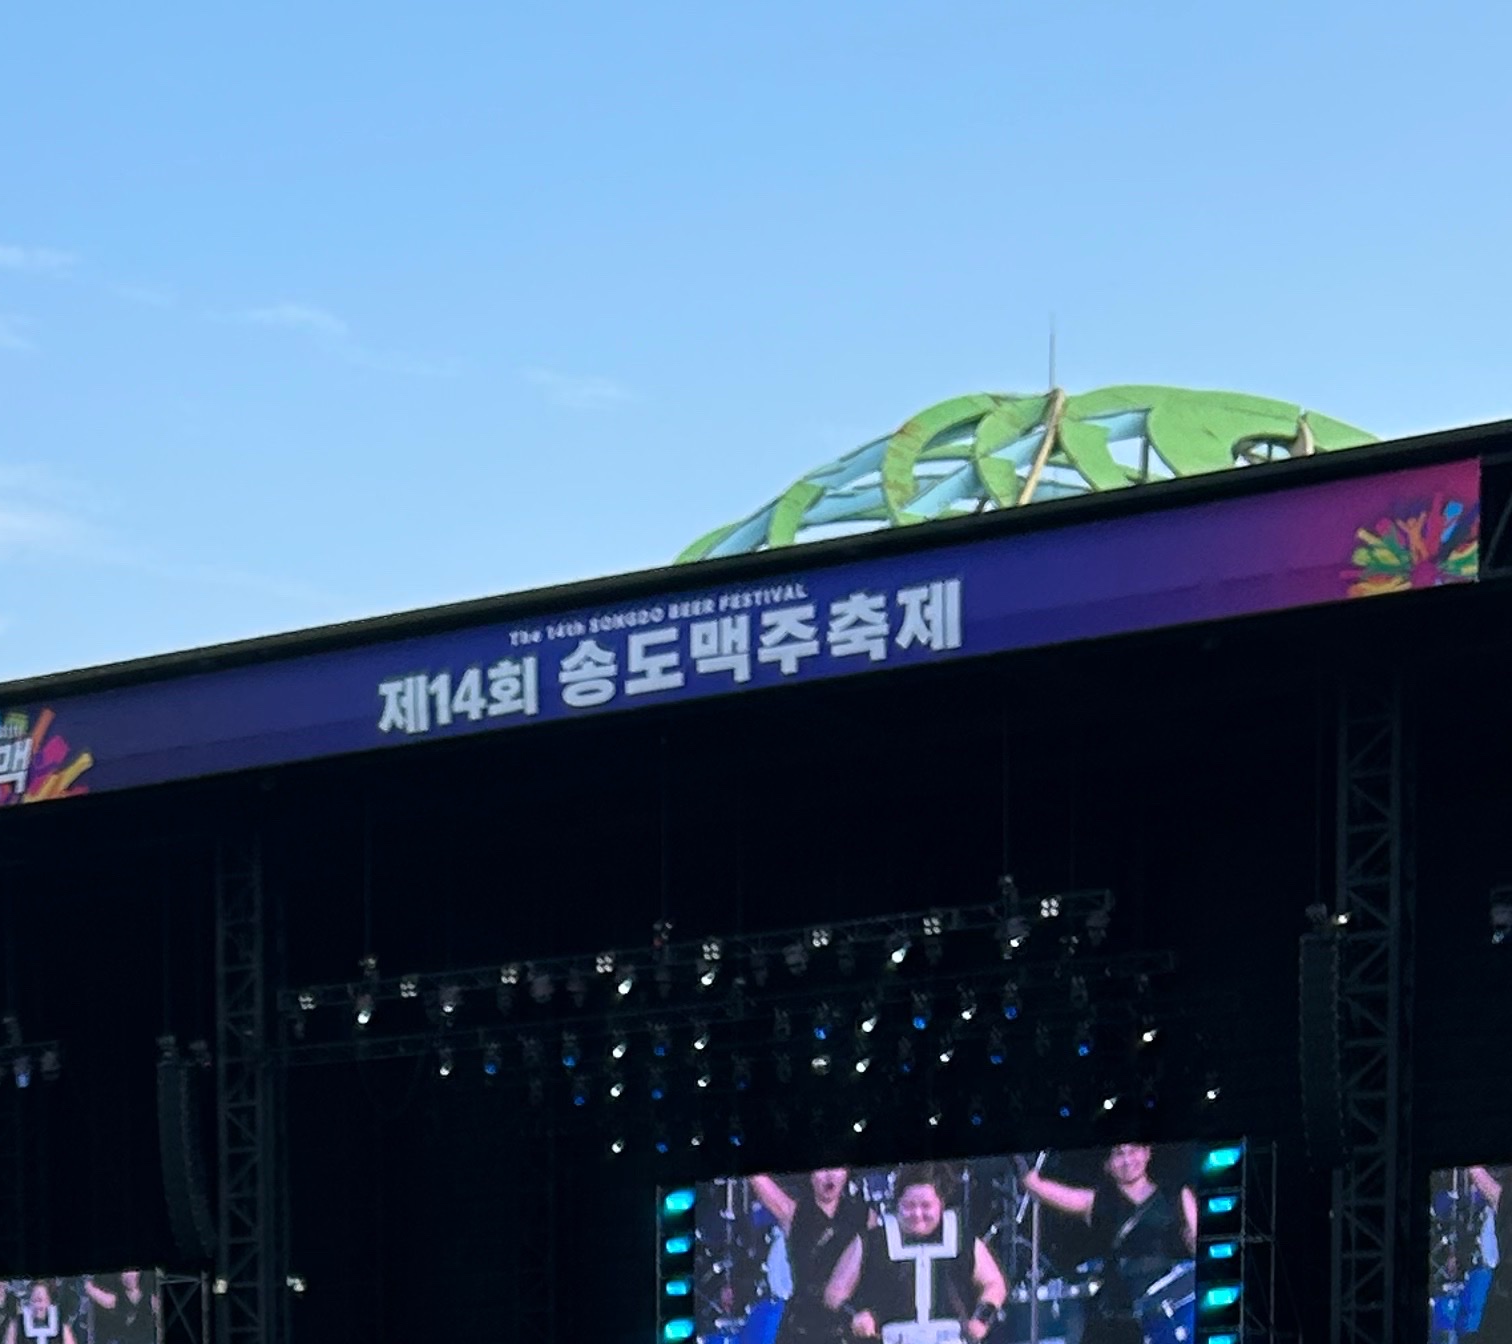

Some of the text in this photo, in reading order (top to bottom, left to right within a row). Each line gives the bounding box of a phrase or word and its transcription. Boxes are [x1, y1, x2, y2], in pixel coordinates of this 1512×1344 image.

[378, 578, 962, 735] 제14회 송도맥주축제
[509, 583, 808, 646] The 14th SONGDO BEER FESTIVAL
